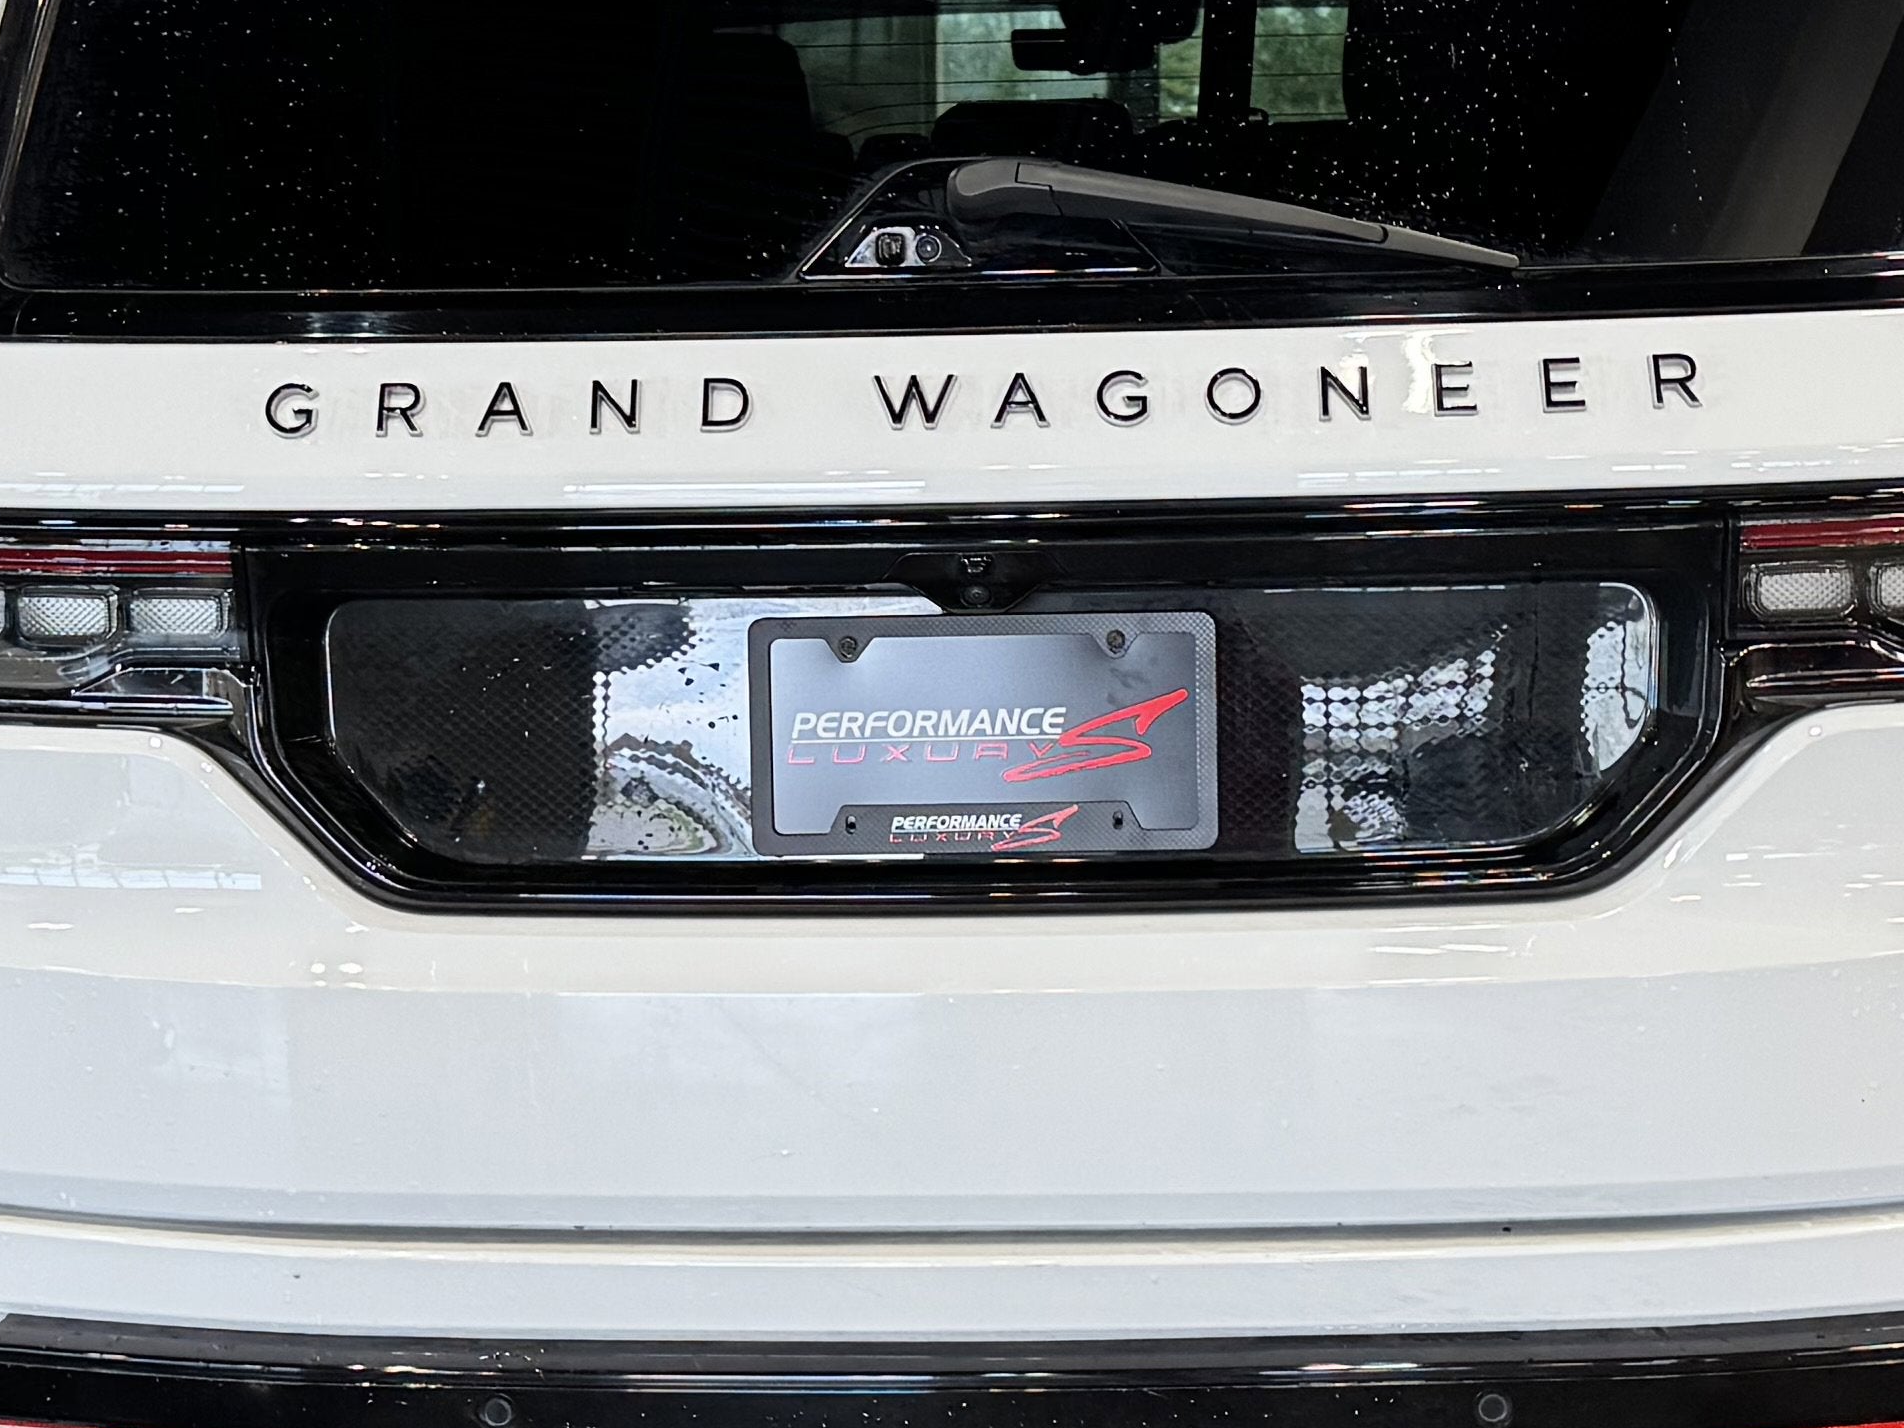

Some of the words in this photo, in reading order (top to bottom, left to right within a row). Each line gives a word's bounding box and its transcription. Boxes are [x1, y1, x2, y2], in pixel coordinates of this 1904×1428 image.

[264, 376, 754, 438] GRAND
[872, 352, 1702, 430] WAGONEER
[791, 706, 1067, 740] PERFORMANCE
[787, 738, 1056, 765] LUXURY
[891, 813, 1023, 830] PERFORMANCE
